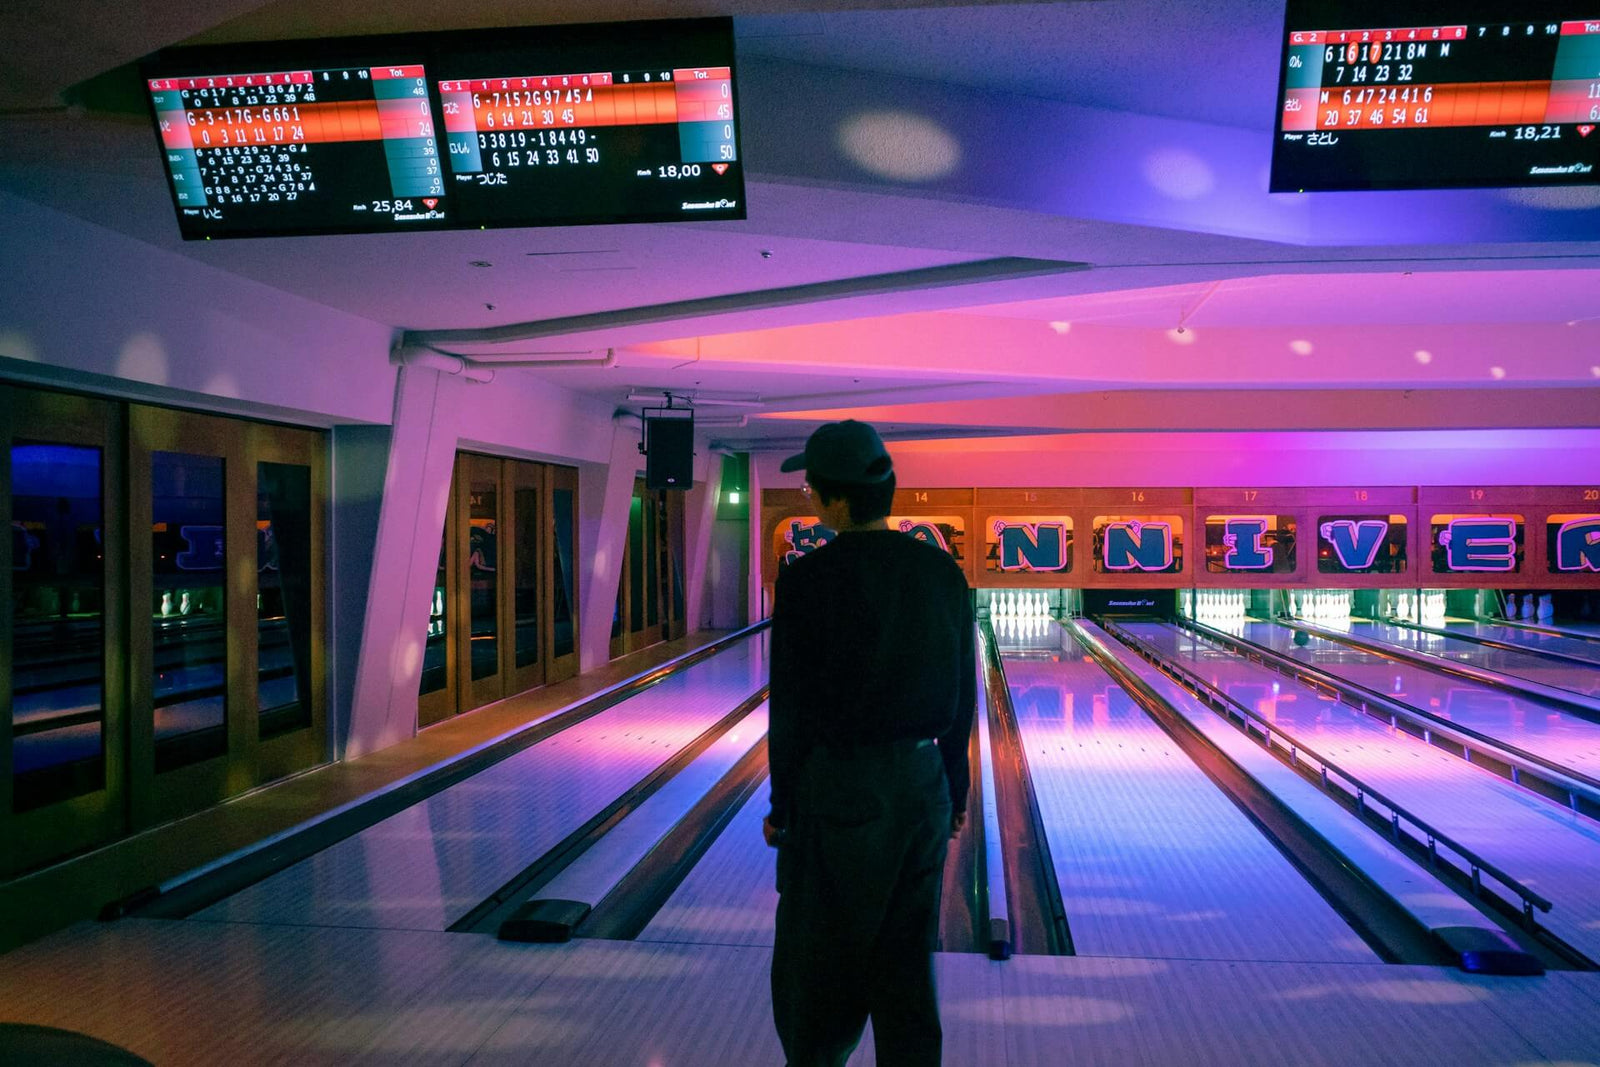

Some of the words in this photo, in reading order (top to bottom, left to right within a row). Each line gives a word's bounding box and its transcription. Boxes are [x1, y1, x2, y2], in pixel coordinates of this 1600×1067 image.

[1363, 32, 1369, 40] 2
[1386, 31, 1392, 39] 3
[1409, 30, 1415, 38] 4
[1456, 29, 1461, 37] 6
[1480, 28, 1485, 36] 7
[1503, 27, 1509, 35] 8
[1528, 26, 1533, 34] 9
[1546, 25, 1557, 33] 10
[1336, 67, 1344, 82] 7
[1353, 66, 1366, 82] 14
[1375, 65, 1389, 81] 23
[1398, 64, 1412, 80] 32
[227, 77, 232, 85] 3
[246, 76, 252, 84] 4
[266, 75, 271, 83] 5
[482, 81, 487, 89] 1
[502, 80, 507, 88] 2
[562, 77, 568, 85] 5
[583, 76, 588, 84] 6
[624, 74, 629, 82] 8
[644, 73, 650, 81] 9
[660, 72, 670, 80] 10
[722, 84, 727, 97] 0
[214, 98, 219, 106] 1
[247, 96, 258, 104] 13
[266, 95, 277, 103] 22
[285, 94, 296, 102] 39
[304, 93, 315, 101] 48
[422, 102, 427, 114] 0
[487, 113, 494, 127] 6
[502, 112, 513, 126] 14
[522, 110, 533, 125] 21
[541, 110, 553, 124] 30
[562, 109, 574, 123] 45
[719, 105, 728, 117] 45
[1325, 110, 1338, 125] 20
[1347, 110, 1361, 125] 37
[1370, 109, 1383, 124] 46
[1392, 109, 1406, 123] 54
[1415, 108, 1427, 122] 61
[202, 130, 210, 144] 0
[221, 129, 228, 143] 3
[235, 129, 247, 142] 11
[254, 128, 266, 141] 11
[273, 126, 283, 140] 17
[291, 126, 303, 140] 24
[420, 123, 430, 135] 24
[725, 125, 730, 138] 0
[1308, 133, 1338, 145] さとし
[1515, 126, 1560, 140] 18,21
[278, 154, 289, 162] 39
[493, 152, 500, 166] 6
[508, 152, 519, 166] 15
[527, 151, 539, 165] 24
[547, 150, 559, 164] 33
[567, 149, 578, 163] 41
[586, 148, 598, 162] 50
[721, 145, 732, 158] 50
[264, 174, 274, 182] 24
[301, 172, 311, 180] 37
[477, 173, 507, 184] つじた
[659, 165, 700, 178] 18,00
[287, 192, 296, 200] 27
[430, 186, 440, 194] 27
[203, 208, 222, 218] いと
[373, 200, 412, 213] 25,84
[915, 493, 927, 502] 14
[1025, 493, 1037, 502] 15
[1132, 493, 1144, 502] 16
[1245, 491, 1257, 501] 17
[1355, 491, 1367, 501] 18
[1471, 490, 1483, 500] 19
[1584, 490, 1598, 500] 20
